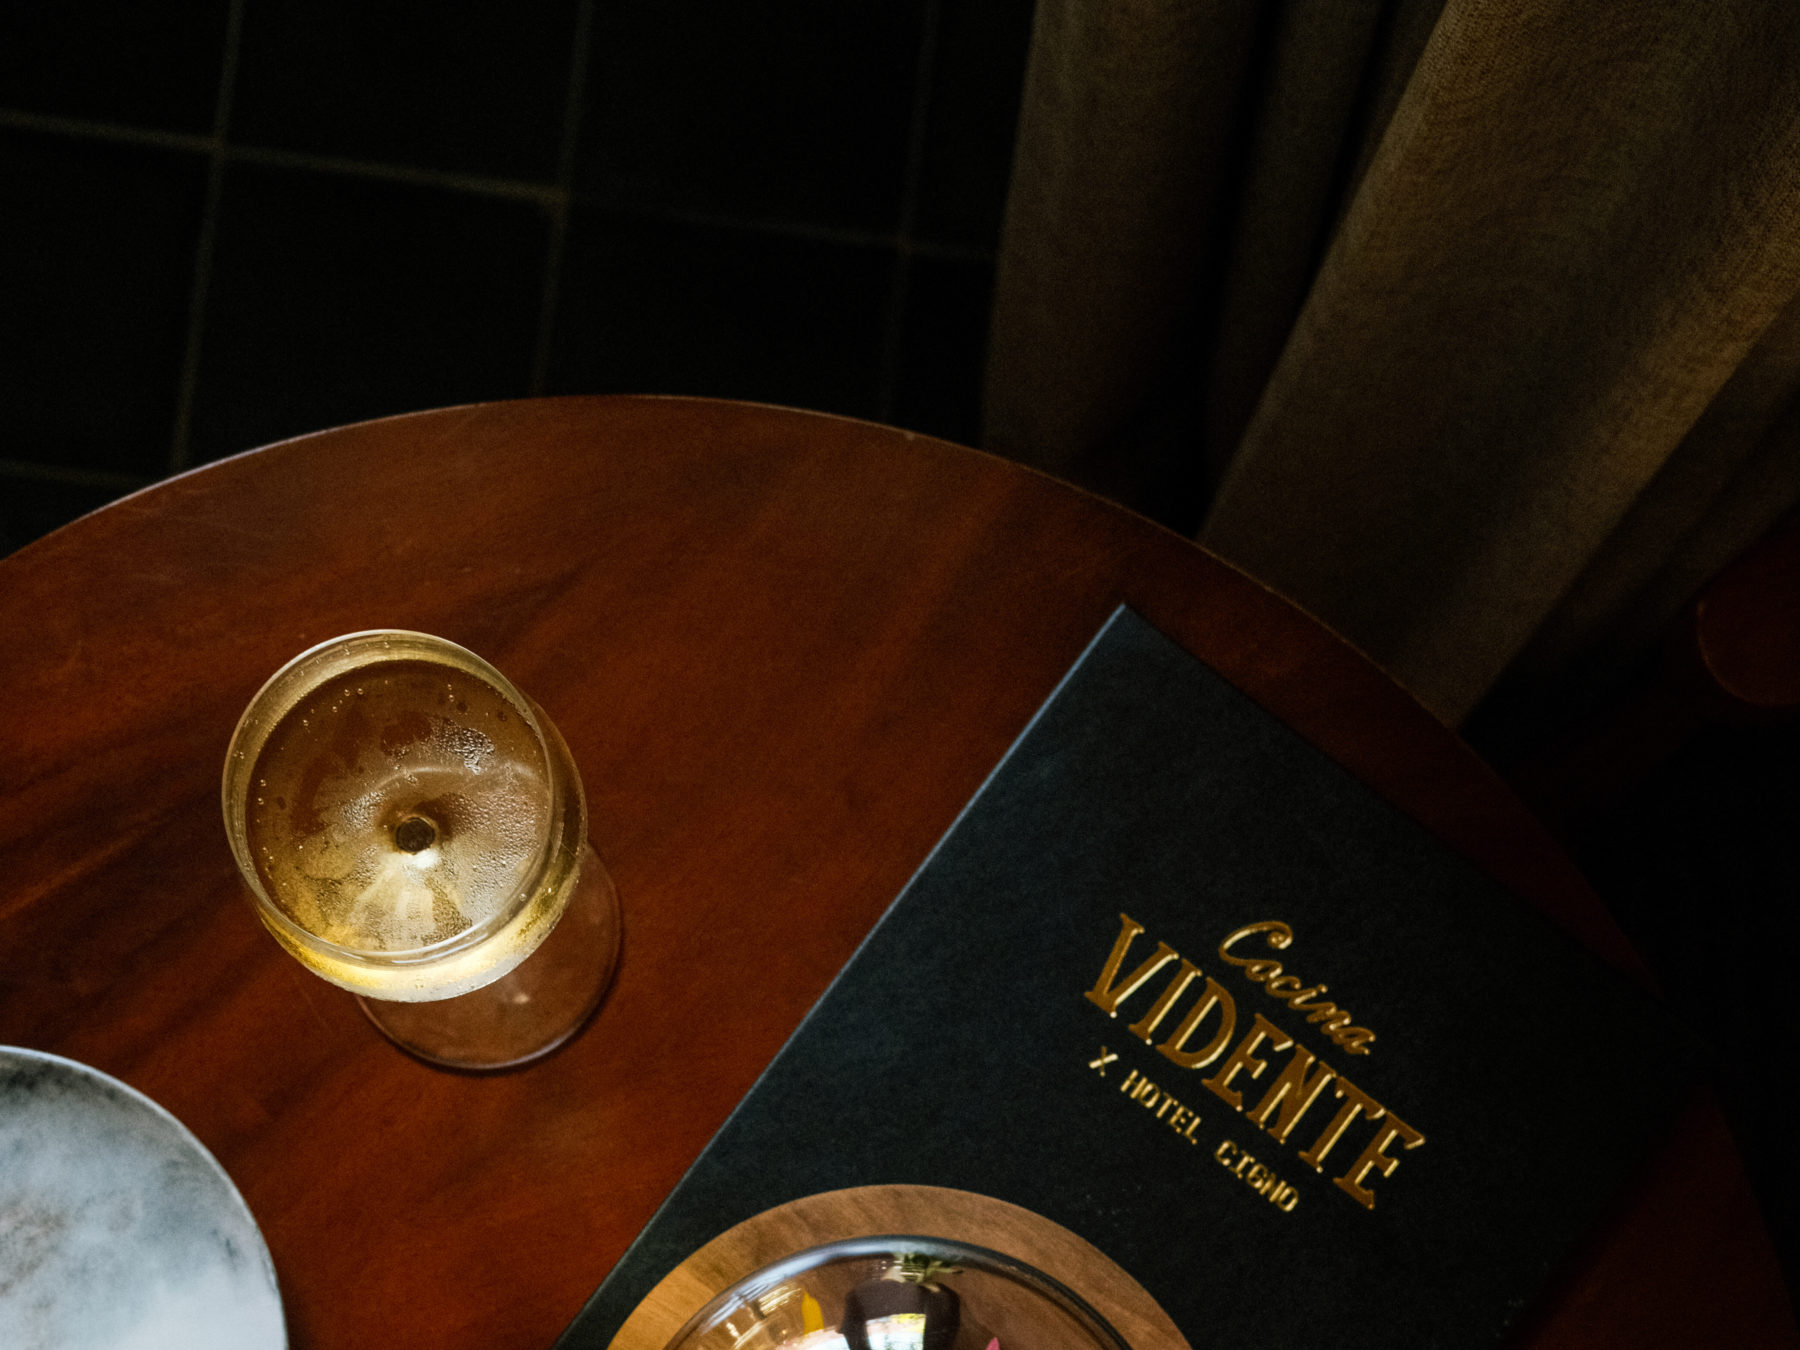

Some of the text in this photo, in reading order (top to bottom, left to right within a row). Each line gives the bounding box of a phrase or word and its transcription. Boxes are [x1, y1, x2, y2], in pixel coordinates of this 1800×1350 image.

[1218, 920, 1376, 1056] Cocina
[1084, 912, 1426, 1210] VIDENTE
[1120, 1069, 1202, 1145] HOTEL
[1214, 1140, 1300, 1213] CIGNO
